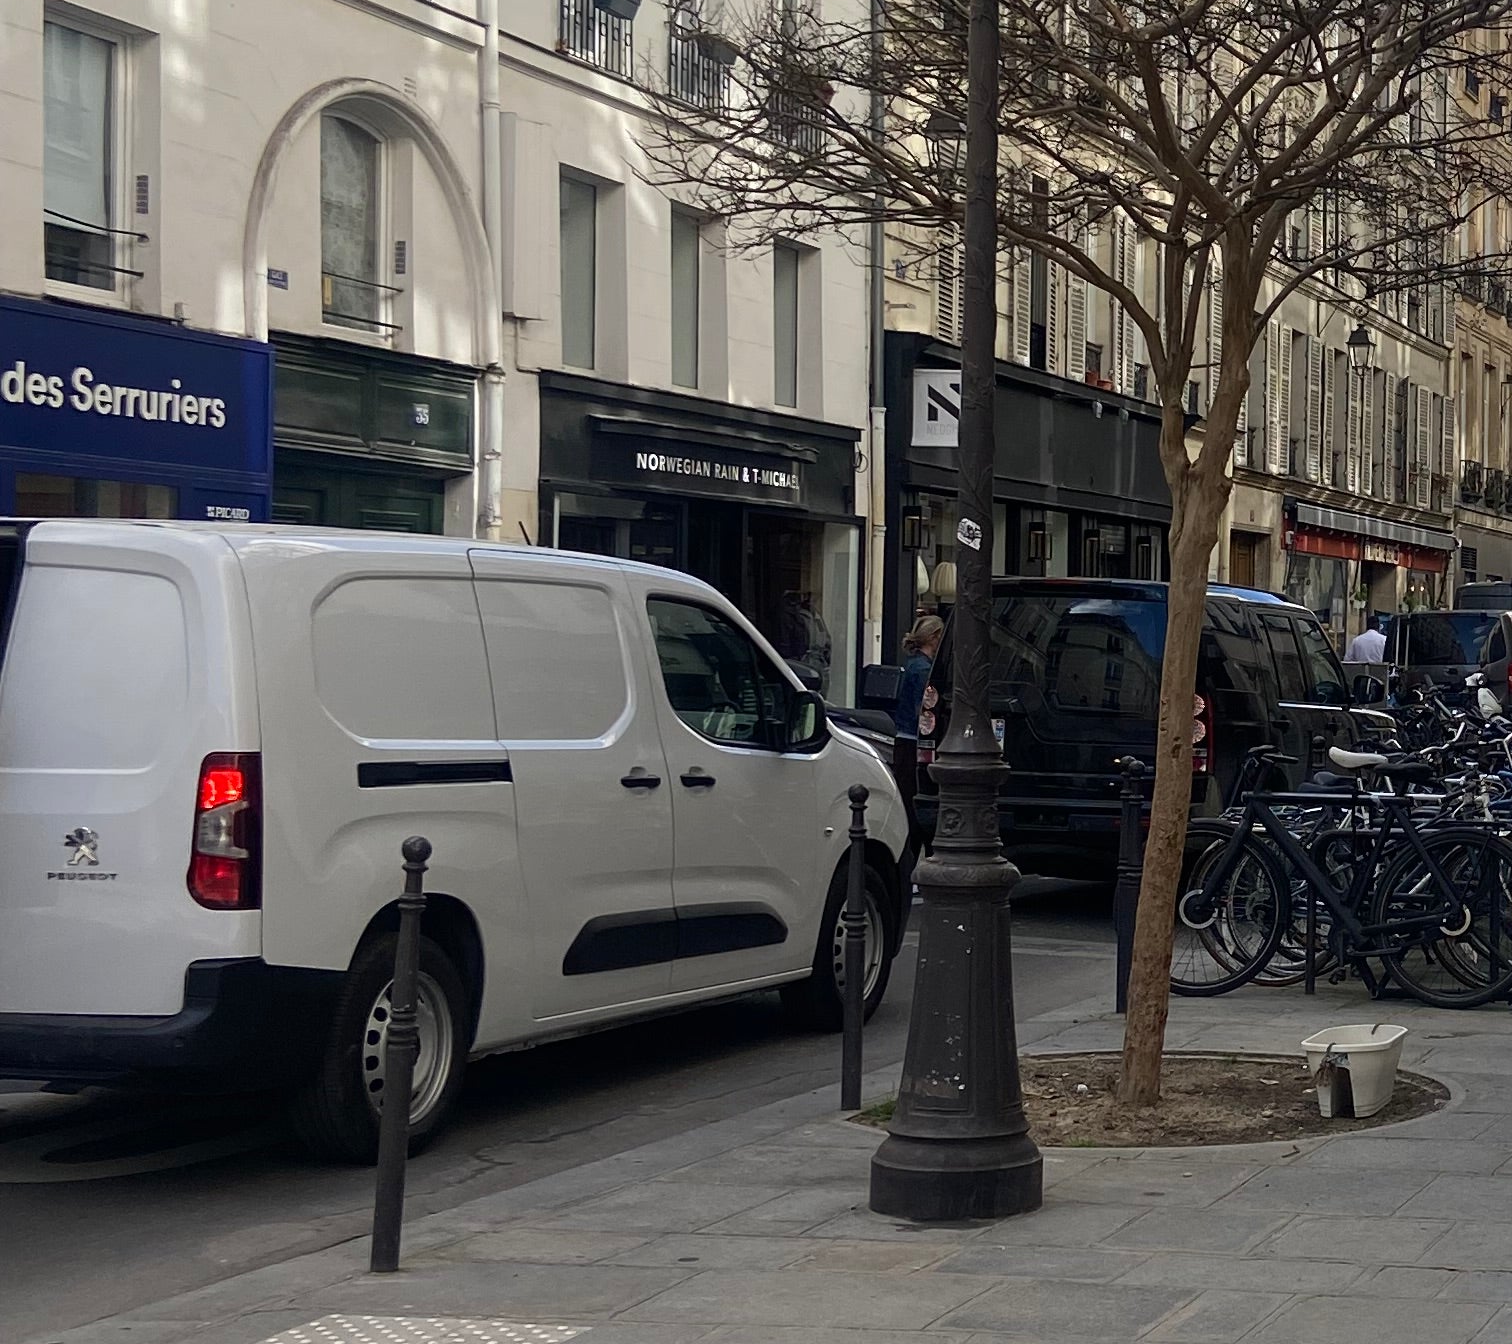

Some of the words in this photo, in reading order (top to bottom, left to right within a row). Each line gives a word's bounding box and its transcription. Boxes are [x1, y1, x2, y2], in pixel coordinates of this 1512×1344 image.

[1, 361, 64, 408] des
[69, 366, 226, 428] Serruriers
[636, 452, 711, 478] NORWEGIAN
[714, 463, 739, 481] RAIN
[742, 467, 750, 483] &
[752, 468, 800, 490] T-MICHAEL
[215, 506, 250, 520] PICARD
[47, 872, 118, 881] PEUGEOT
